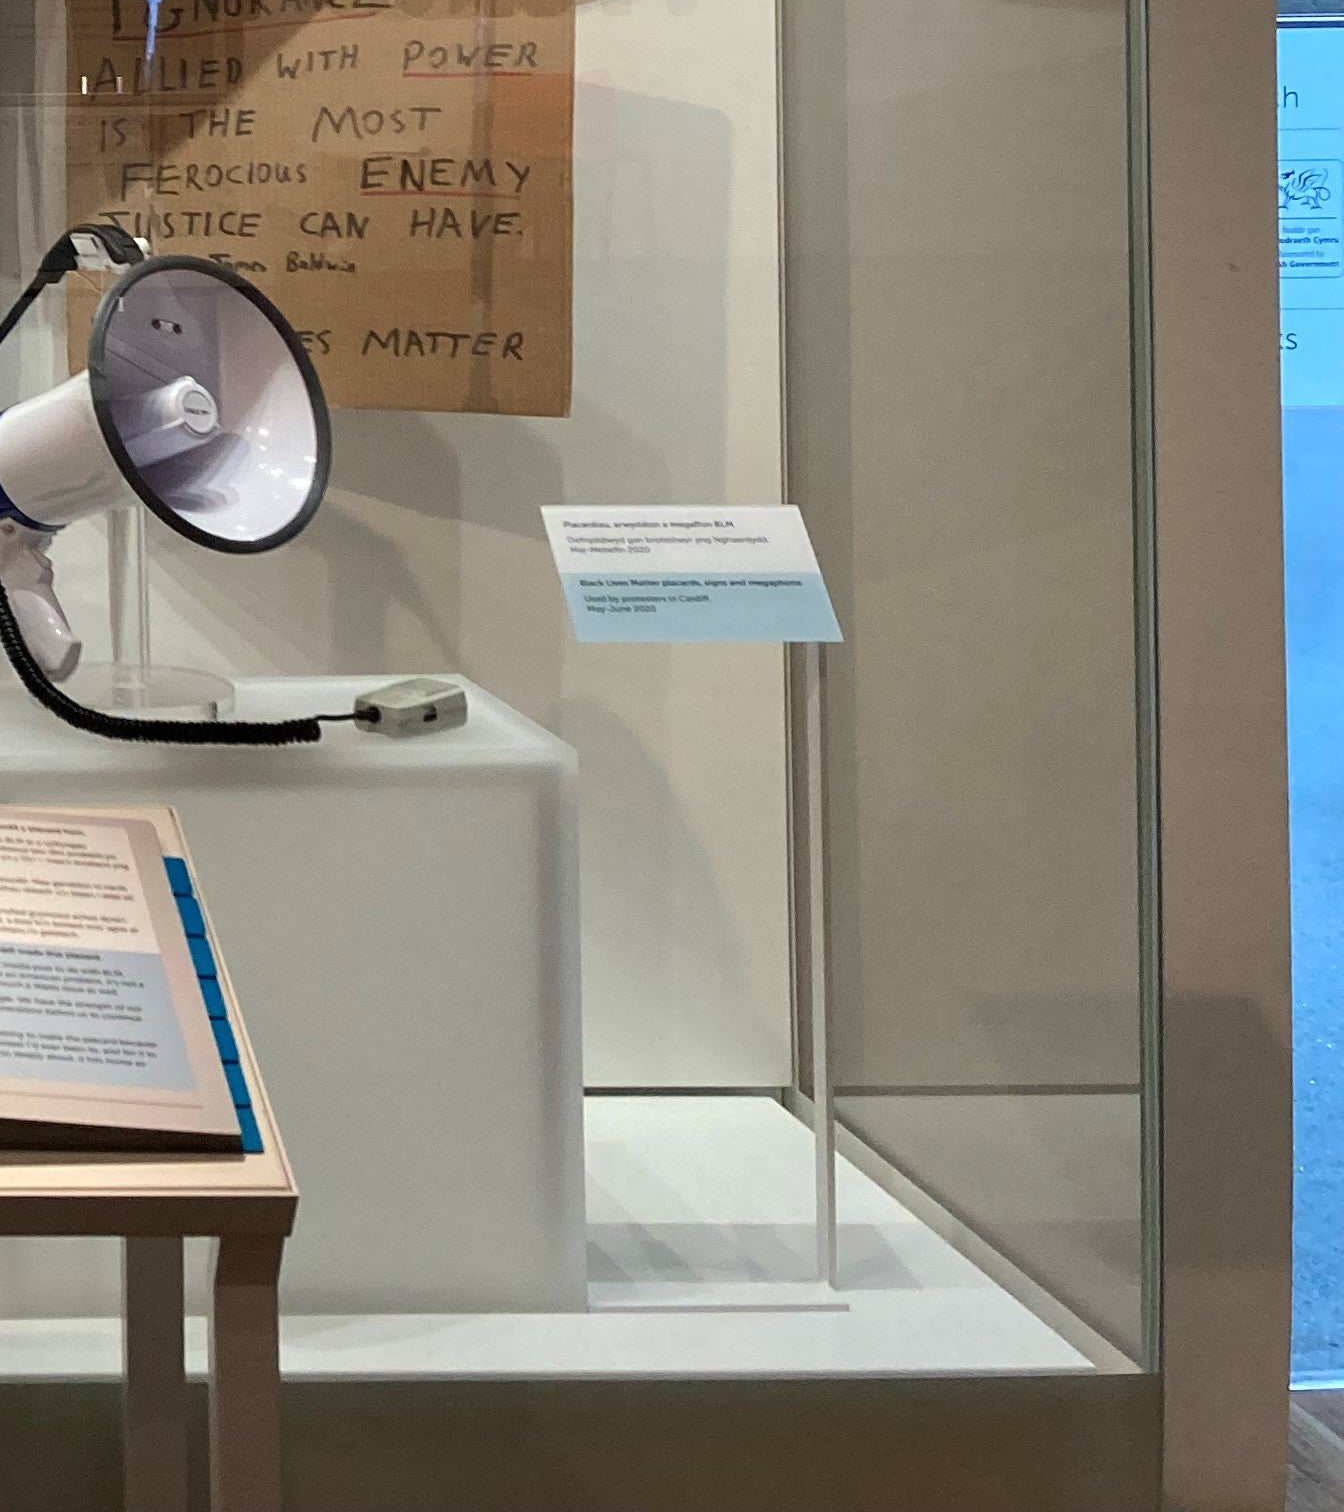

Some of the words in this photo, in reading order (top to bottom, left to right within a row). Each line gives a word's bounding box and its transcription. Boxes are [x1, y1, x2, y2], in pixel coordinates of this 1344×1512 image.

[277, 45, 360, 79] WITH
[402, 40, 538, 70] POWER
[99, 118, 127, 153] IS
[178, 109, 257, 138] THE
[312, 106, 441, 142] MOST
[360, 156, 531, 193] ENEMY
[300, 212, 369, 238] CAN
[362, 328, 525, 361] MATTER
